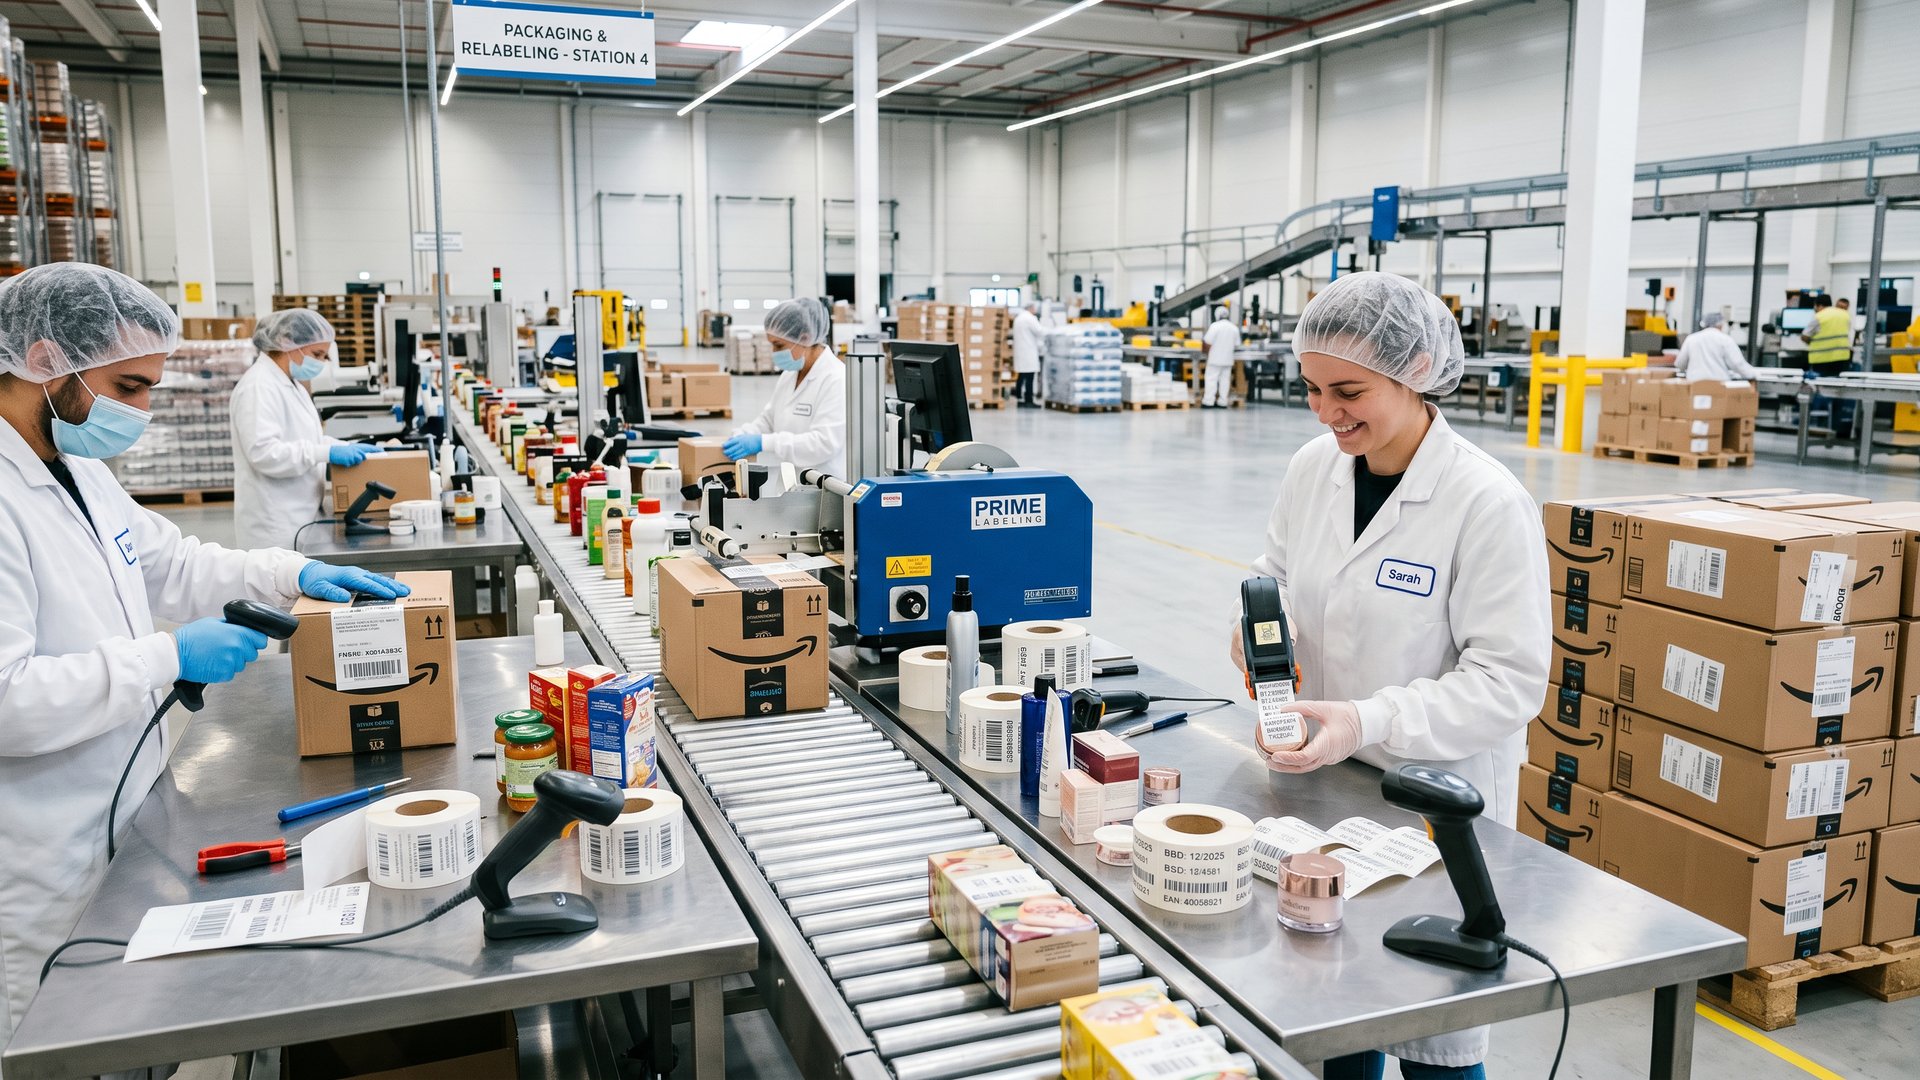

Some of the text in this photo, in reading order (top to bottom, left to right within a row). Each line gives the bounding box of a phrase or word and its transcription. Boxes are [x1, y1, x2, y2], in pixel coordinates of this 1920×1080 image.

[504, 23, 607, 43] PACKAGING &
[461, 41, 559, 60] RELABELING
[573, 49, 635, 65] STATION
[640, 53, 649, 66] 4
[975, 498, 1042, 517] PRIME
[975, 515, 1042, 527] LABELING
[1388, 568, 1421, 585] Sarah
[1164, 848, 1225, 861] BBD: 12/2025
[1164, 864, 1187, 875] BSD:
[1163, 894, 1182, 905] EAN:
